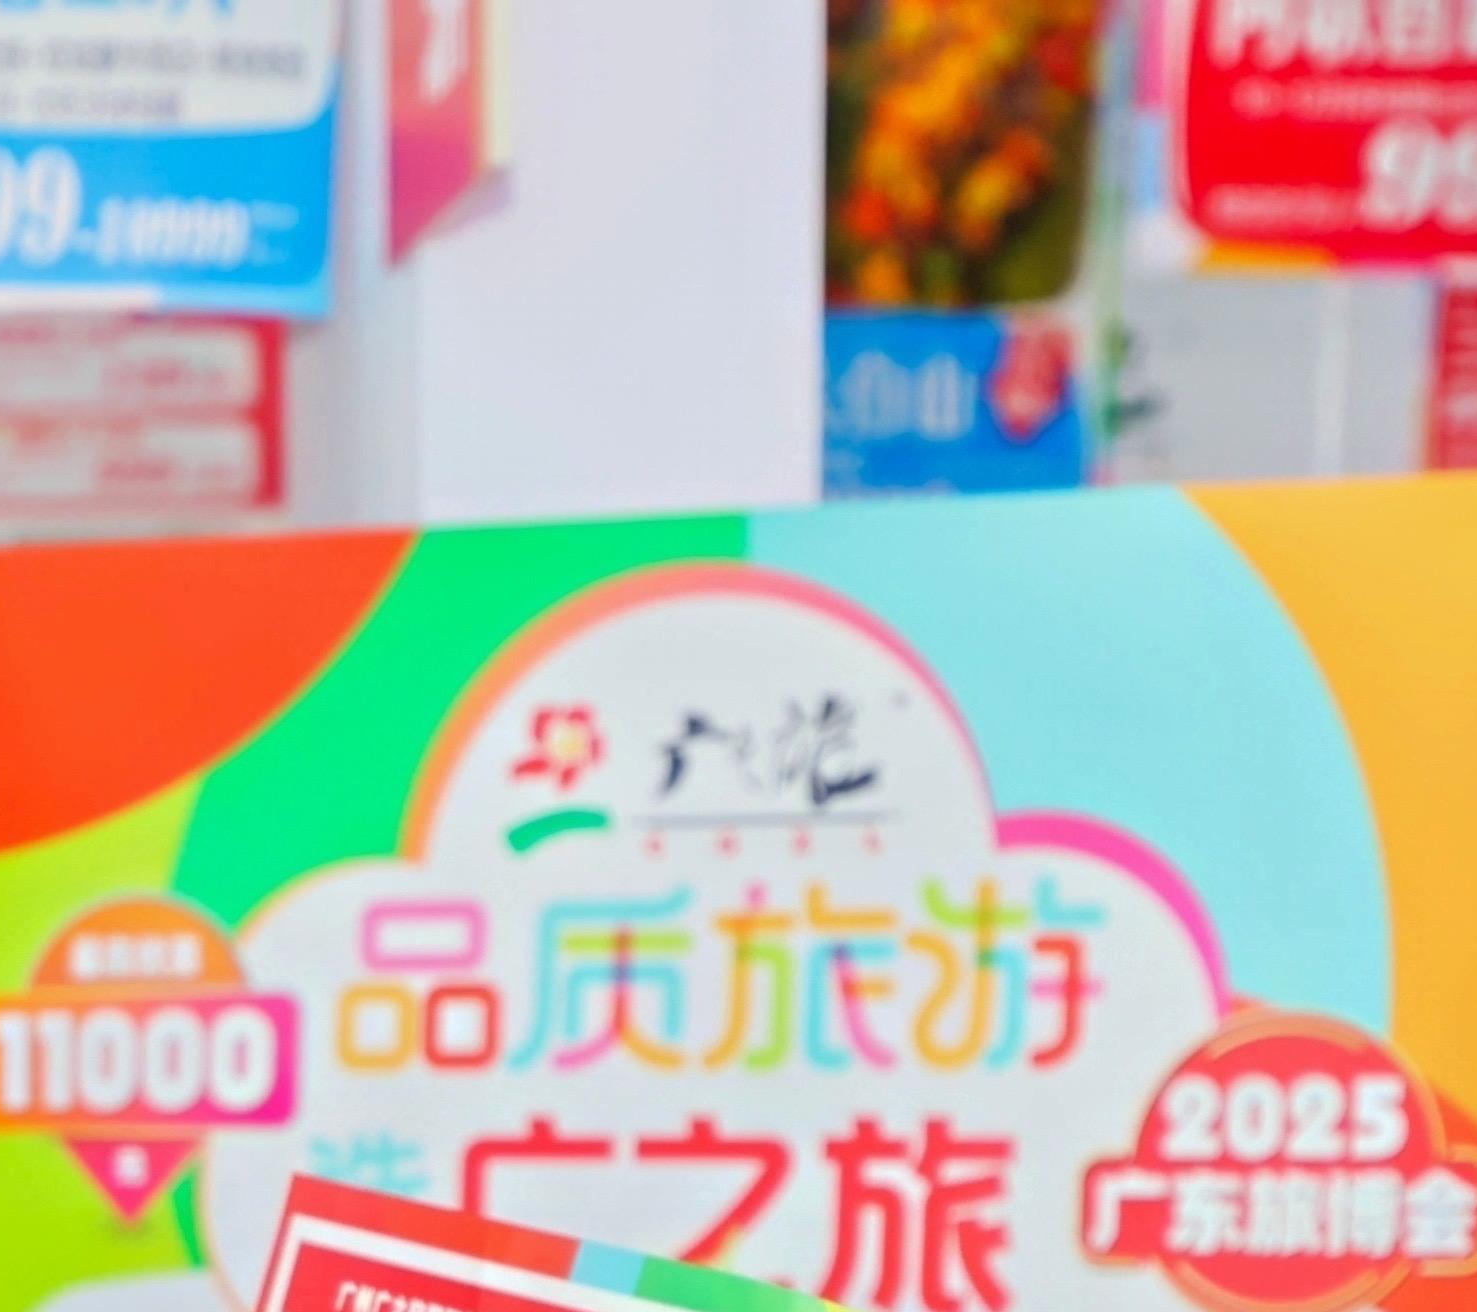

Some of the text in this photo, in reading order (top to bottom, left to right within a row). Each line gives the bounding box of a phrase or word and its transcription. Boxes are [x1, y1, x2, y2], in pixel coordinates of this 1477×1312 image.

[335, 874, 1108, 1071] 品质旅游
[1160, 1076, 1408, 1161] 2025
